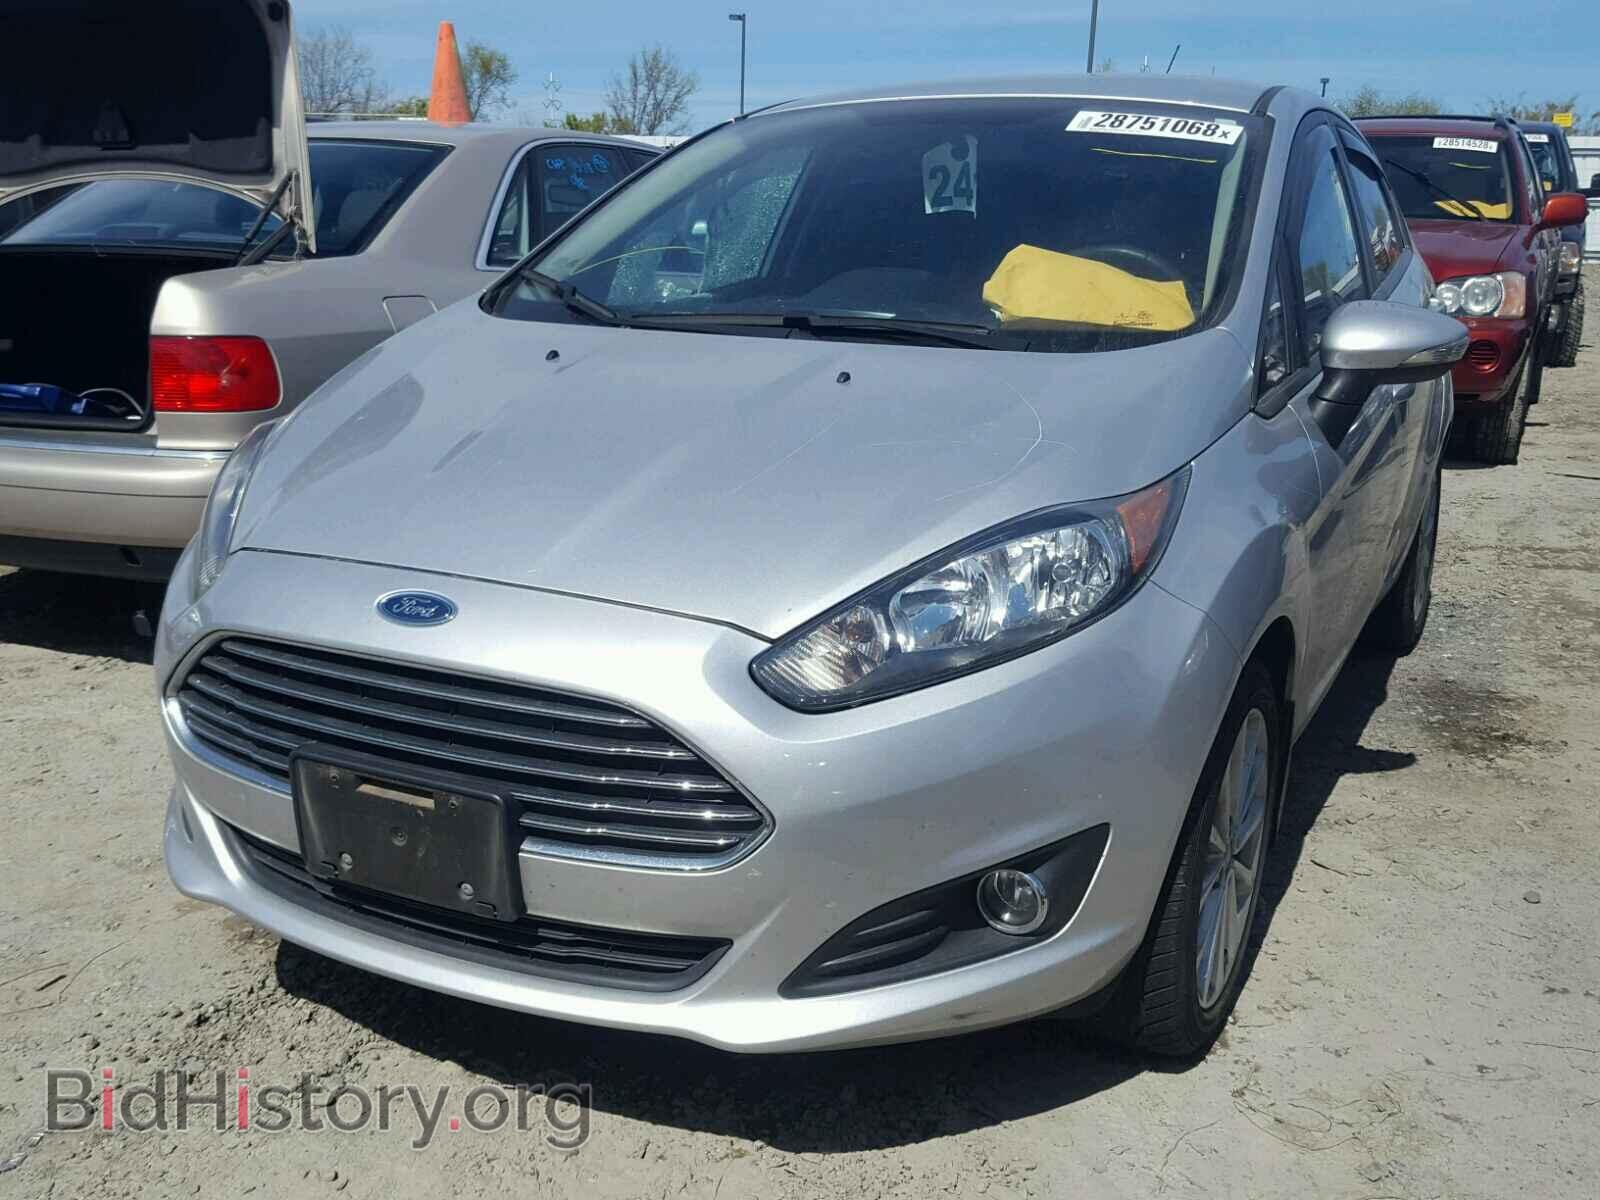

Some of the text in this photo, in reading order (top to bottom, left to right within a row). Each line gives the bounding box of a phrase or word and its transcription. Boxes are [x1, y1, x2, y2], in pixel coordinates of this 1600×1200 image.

[1093, 113, 1220, 138] 28751068
[927, 160, 974, 208] 24
[392, 596, 441, 618] Ford
